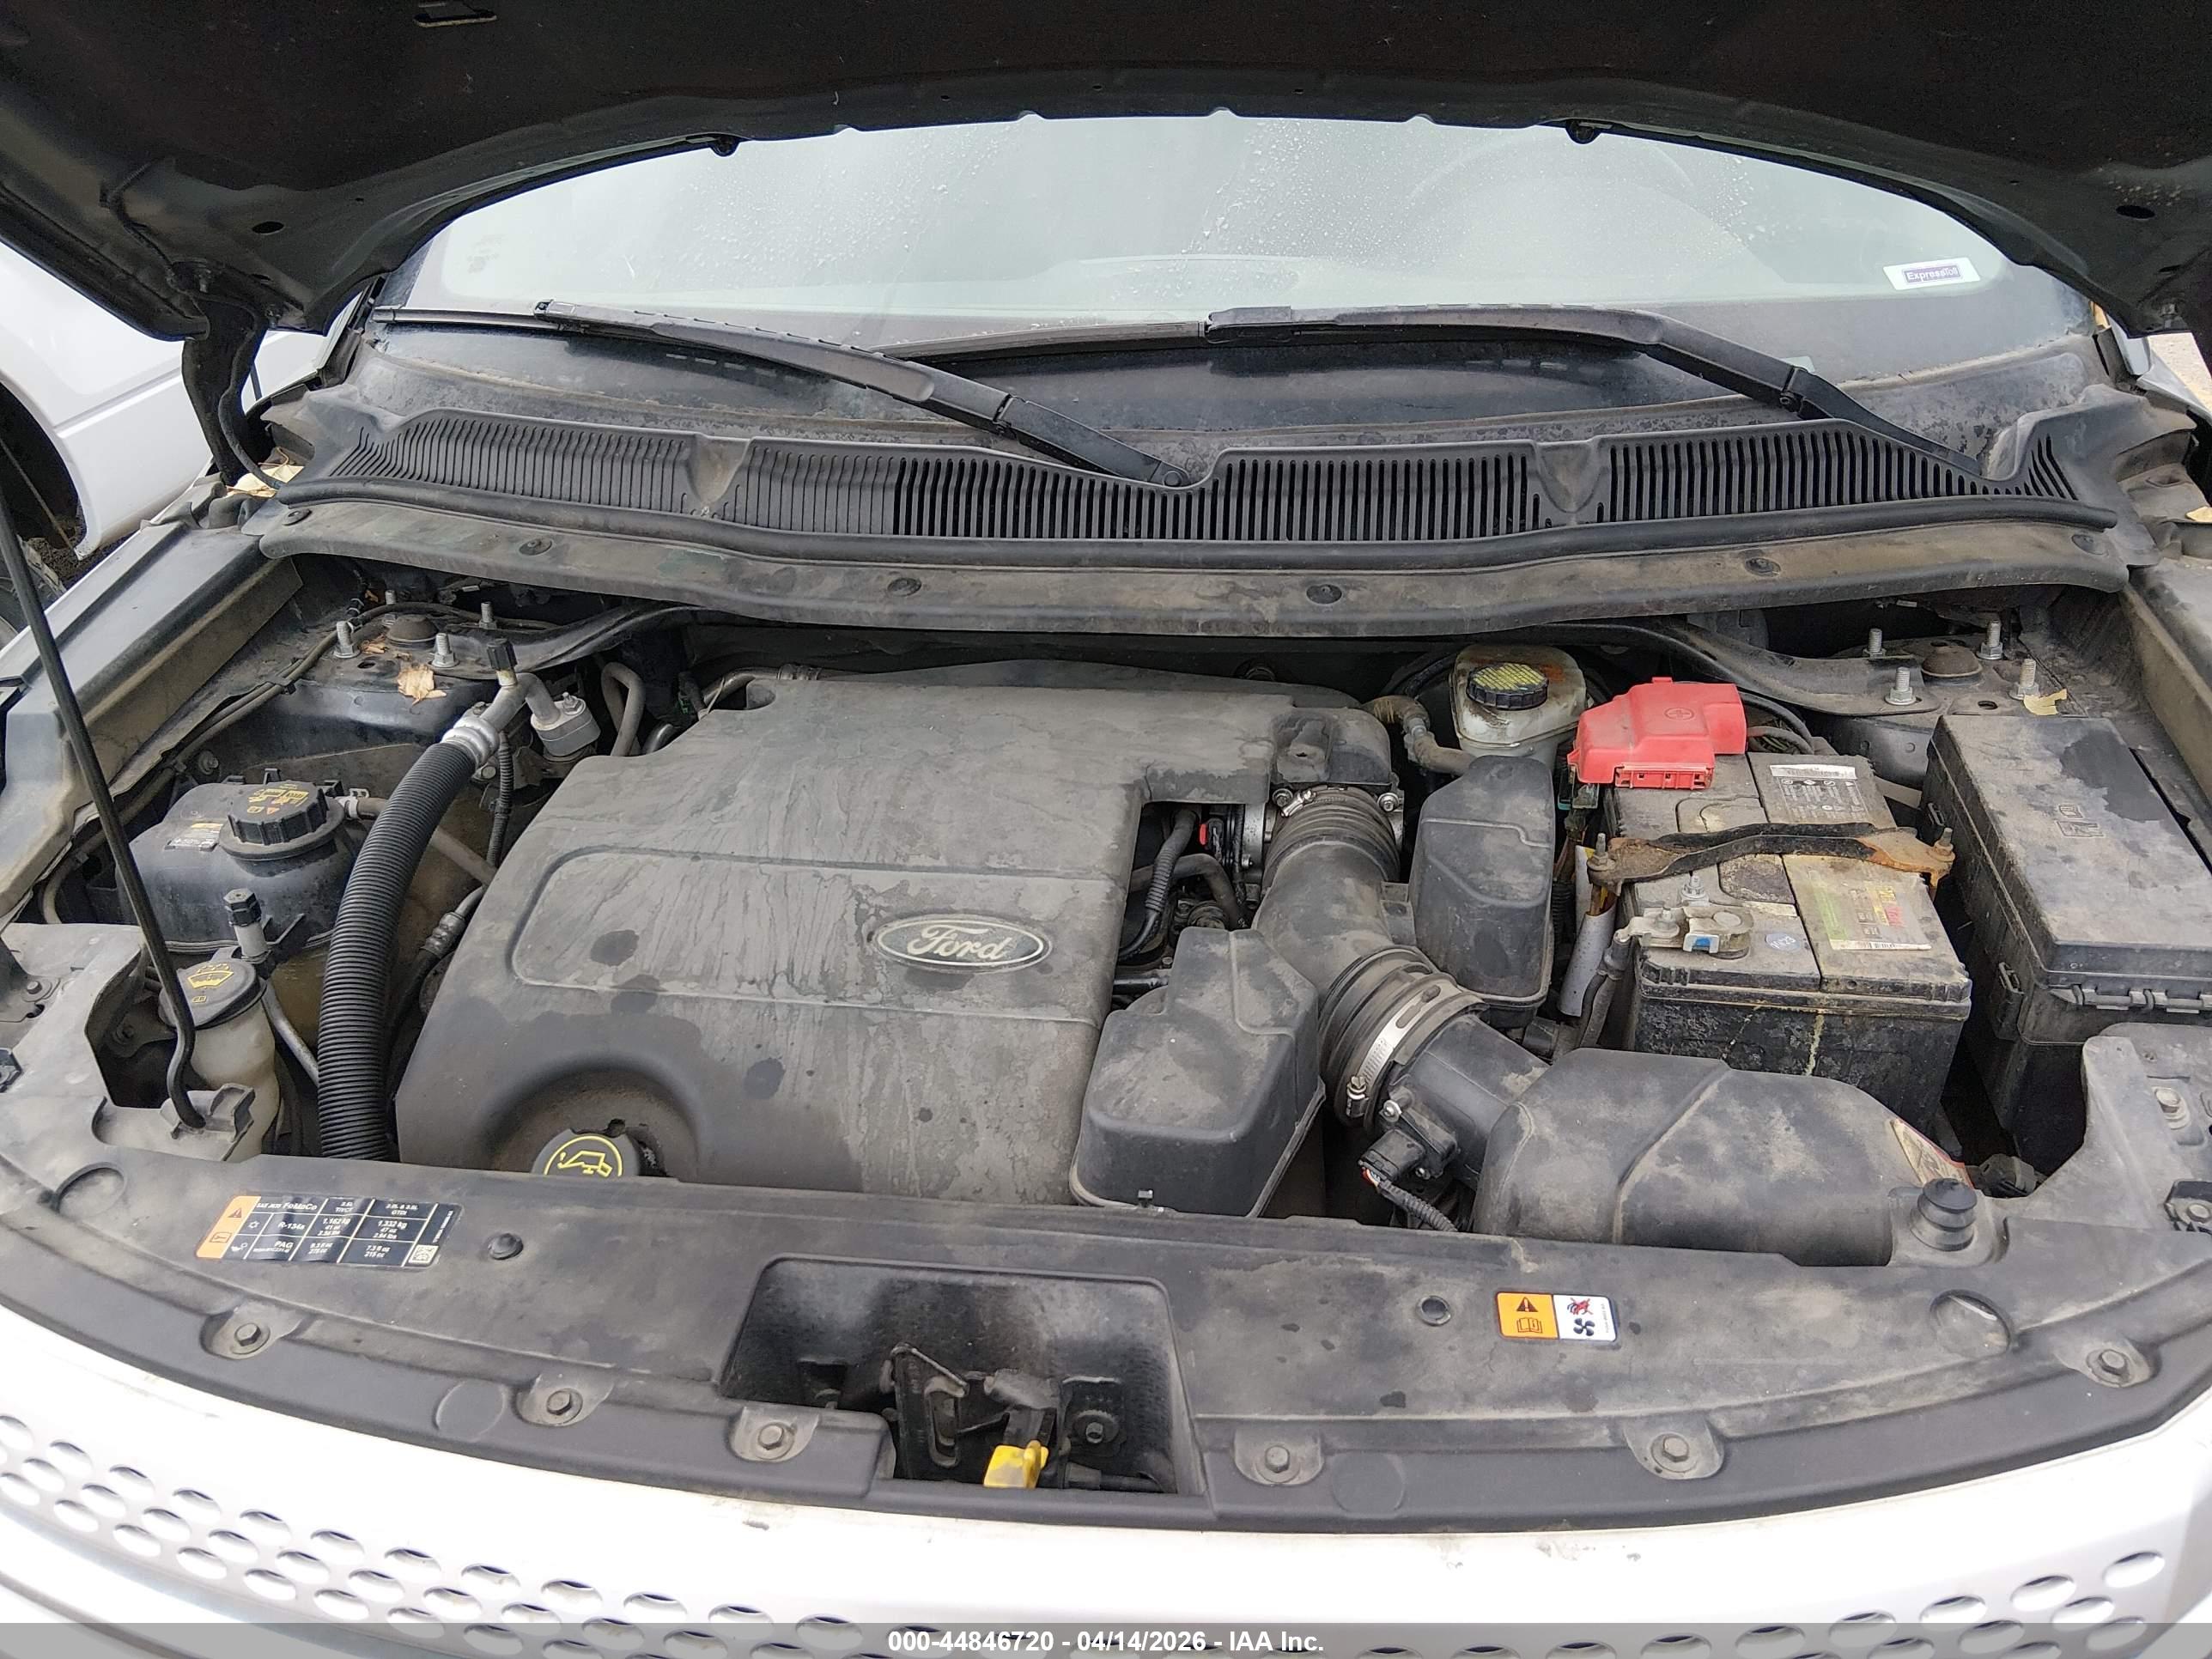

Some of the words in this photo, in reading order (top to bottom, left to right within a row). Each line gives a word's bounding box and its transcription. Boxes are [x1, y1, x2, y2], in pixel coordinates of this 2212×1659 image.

[1905, 267, 1959, 282] ExpressToll
[907, 924, 1013, 960] Ford
[283, 1201, 318, 1211] FoMoCo
[277, 1221, 306, 1230] R-134a
[398, 1221, 408, 1230] kg
